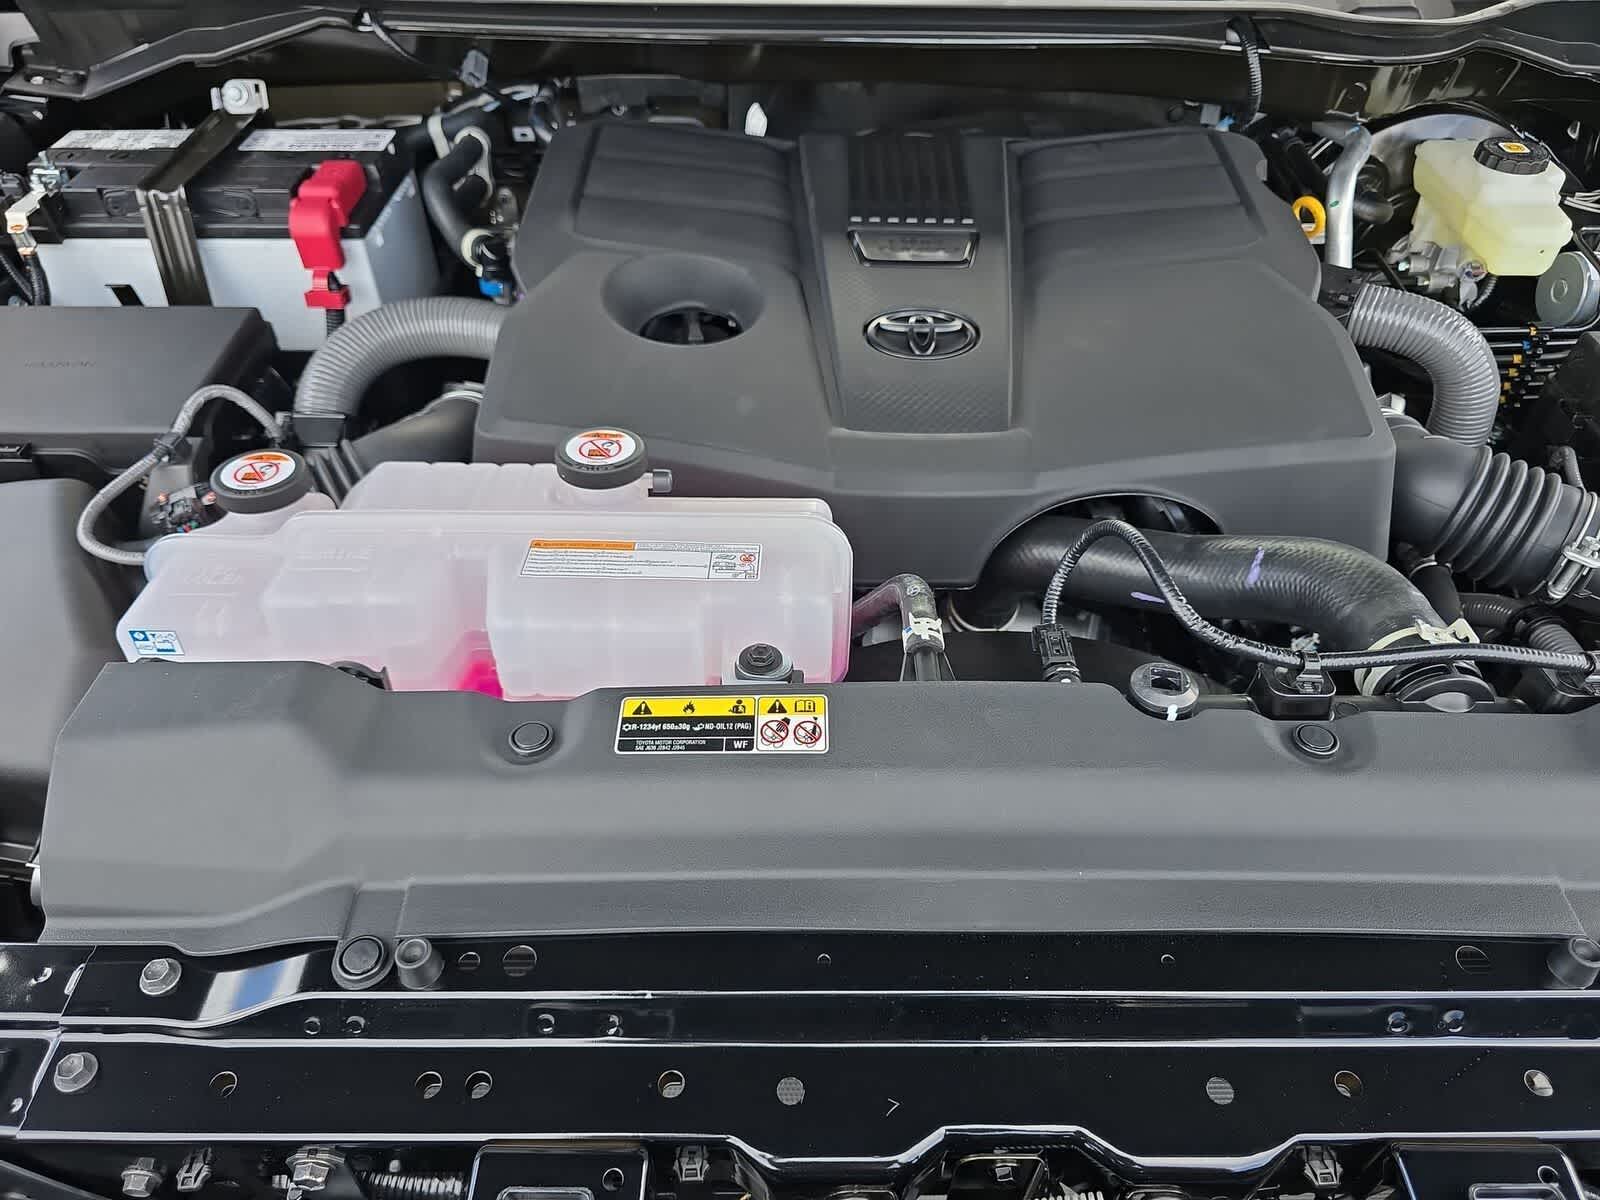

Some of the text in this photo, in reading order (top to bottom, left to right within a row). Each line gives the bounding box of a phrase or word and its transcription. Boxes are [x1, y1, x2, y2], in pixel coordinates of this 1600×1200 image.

[705, 722, 752, 730] ND-OIL12 (PAG)
[733, 740, 749, 749] WF
